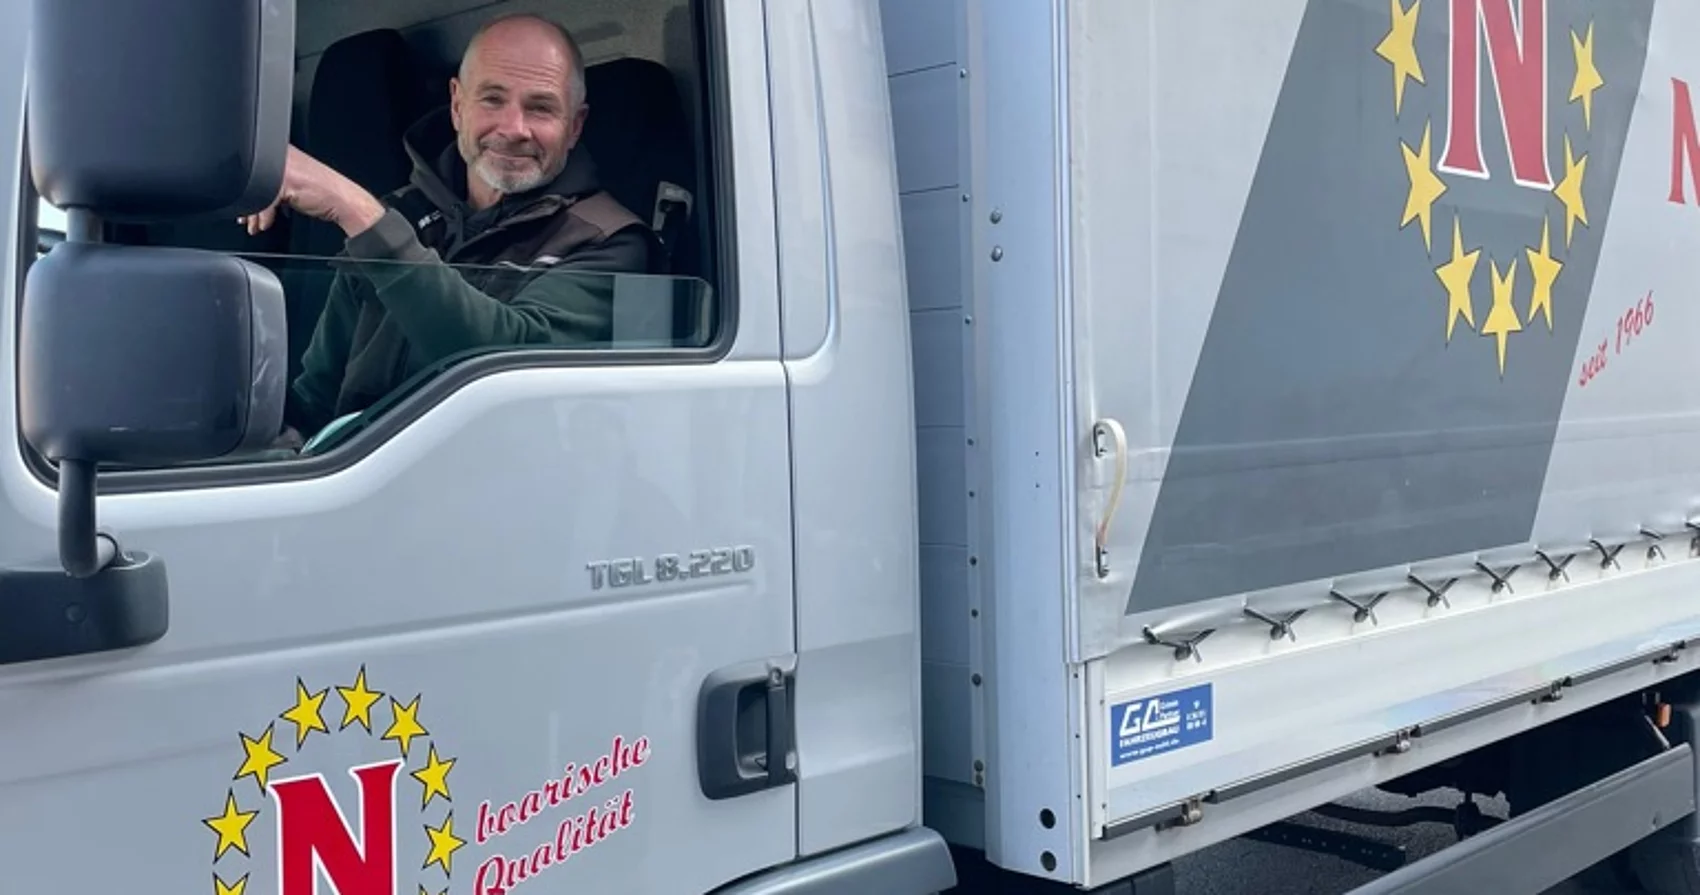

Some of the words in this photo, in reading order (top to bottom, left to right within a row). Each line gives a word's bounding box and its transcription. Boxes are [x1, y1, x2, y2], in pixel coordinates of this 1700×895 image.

[1437, 0, 1555, 191] N
[1615, 289, 1655, 355] 1966
[584, 556, 652, 590] TGL
[655, 544, 755, 582] 8.220
[266, 758, 406, 895] N
[473, 788, 636, 895] Qualität
[476, 734, 652, 845] boarische
